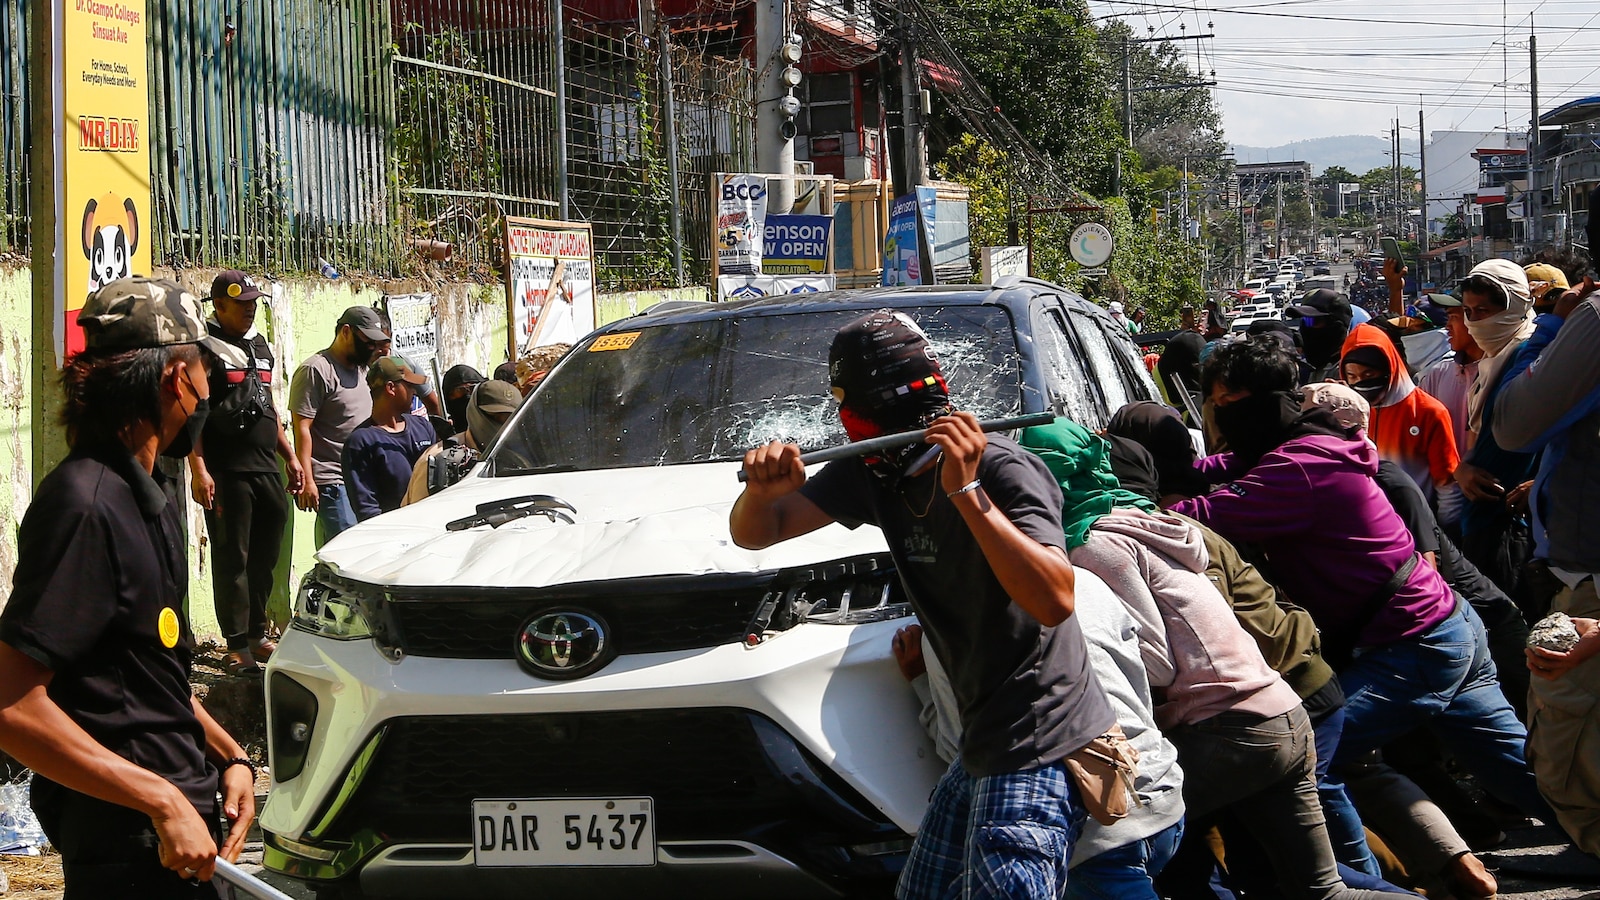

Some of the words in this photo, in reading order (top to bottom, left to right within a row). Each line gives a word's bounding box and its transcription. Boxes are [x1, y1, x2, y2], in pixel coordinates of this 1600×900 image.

[76, 0, 86, 12] Dr.
[87, 0, 114, 21] Ocampo
[115, 3, 140, 26] Colleges
[92, 21, 116, 41] Sinsuat
[117, 27, 128, 43] Ave
[99, 60, 113, 73] Home,
[114, 62, 129, 75] School,
[82, 71, 102, 86] Everyday
[103, 74, 116, 86] Needs
[125, 77, 137, 88] More!
[763, 225, 825, 240] enson
[781, 242, 824, 256] OPEN
[395, 330, 415, 349] Suite
[479, 815, 540, 851] DAR
[564, 813, 648, 851] 5437
